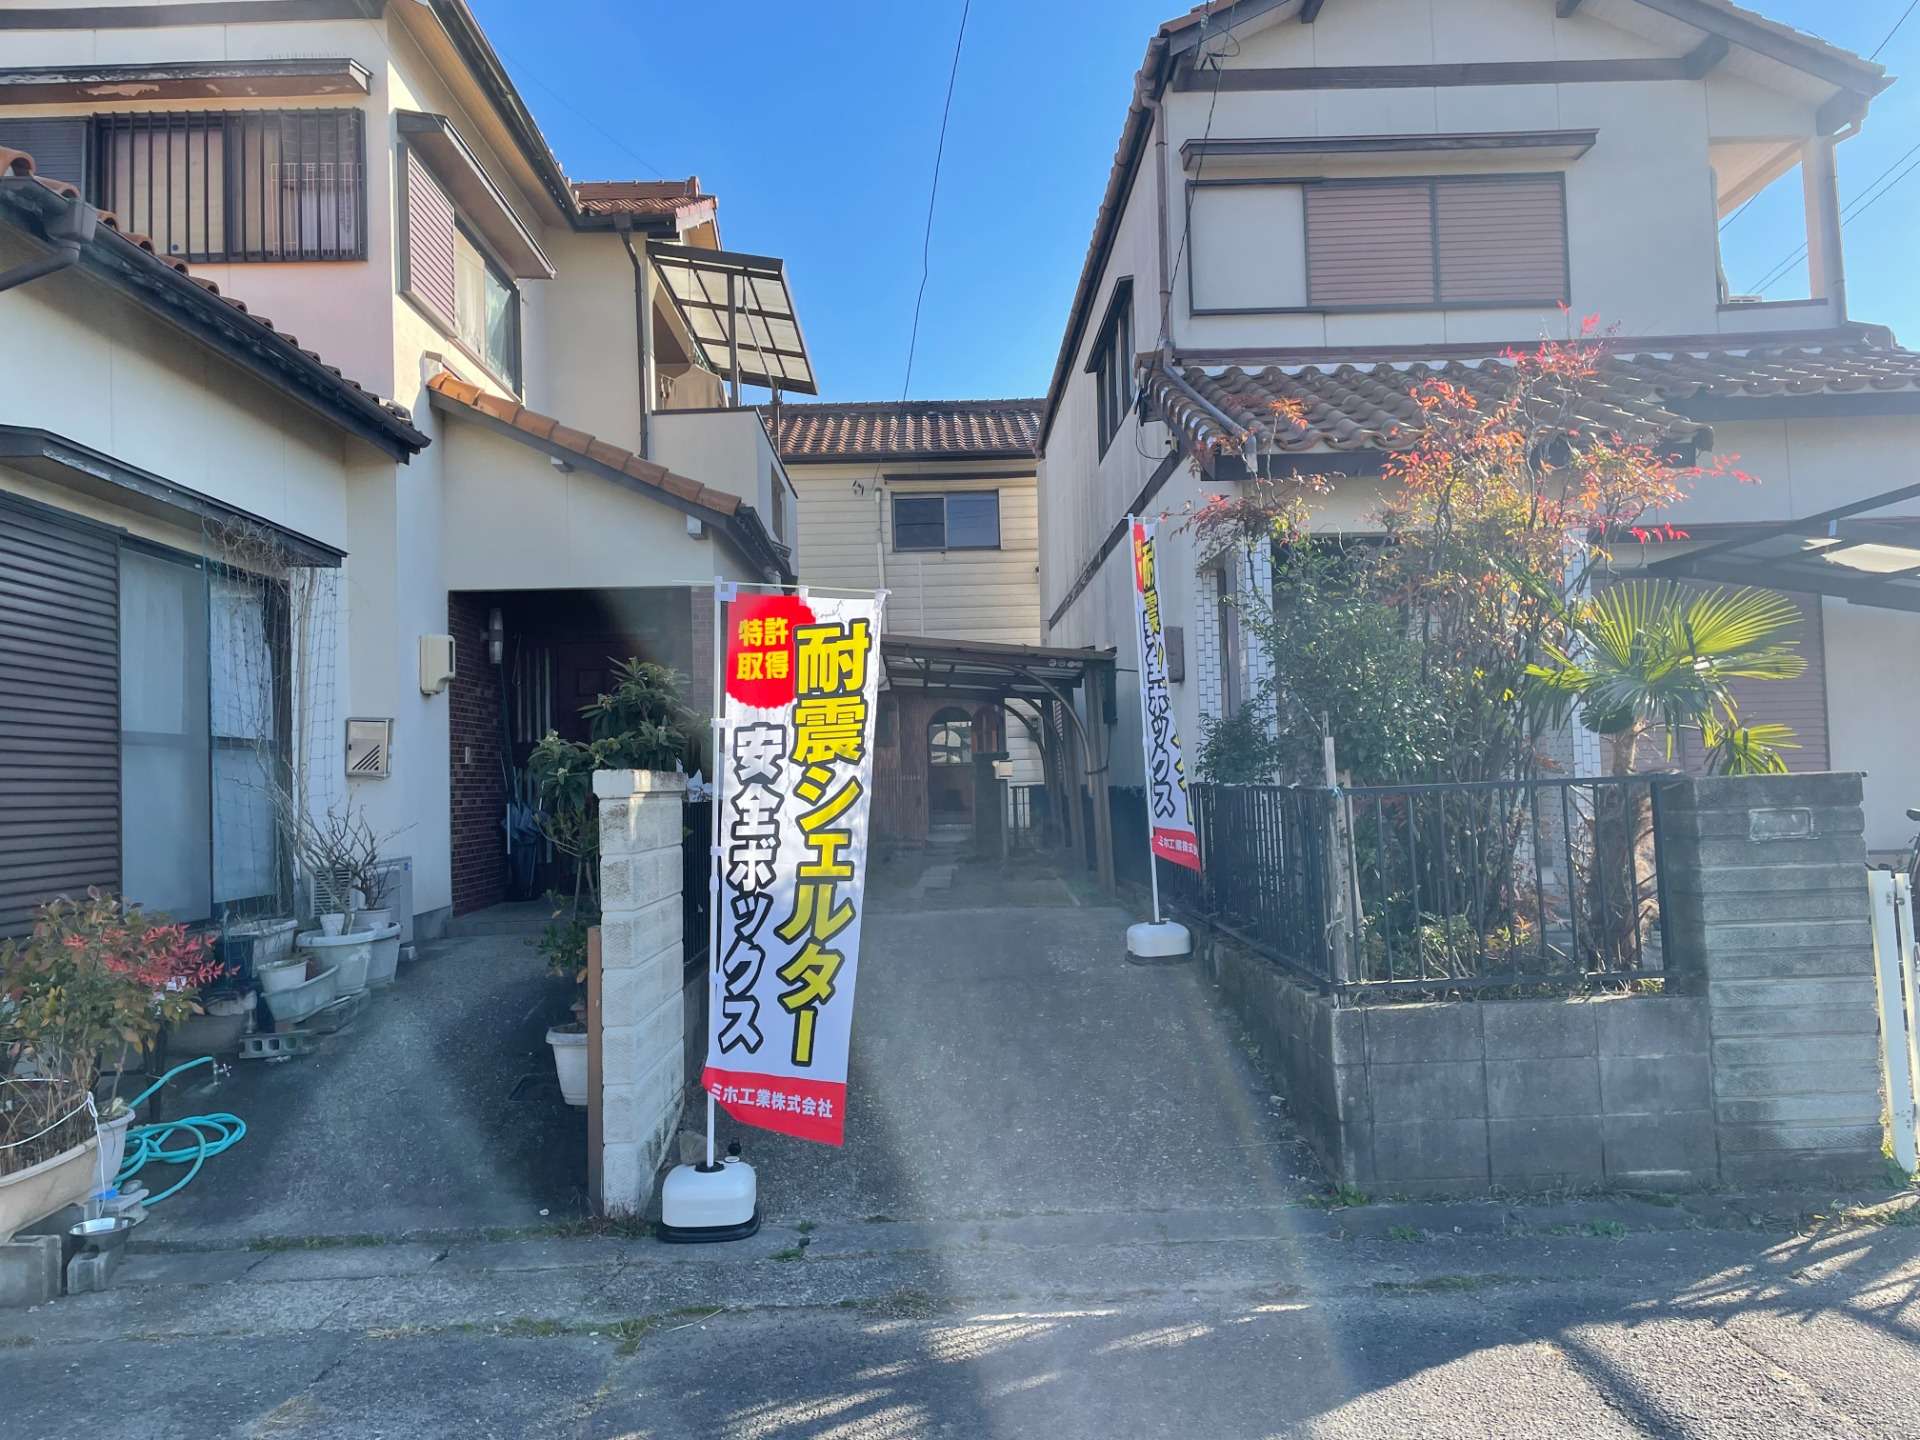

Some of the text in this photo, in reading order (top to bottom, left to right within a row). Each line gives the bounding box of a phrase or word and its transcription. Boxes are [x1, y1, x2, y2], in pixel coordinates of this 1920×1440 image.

[738, 617, 788, 647] 特許
[736, 650, 789, 680] 取得
[774, 618, 872, 1067] 耐震シェルター
[718, 722, 786, 1054] 安全ボックス
[711, 1083, 833, 1118] ミホ工業株式会社
